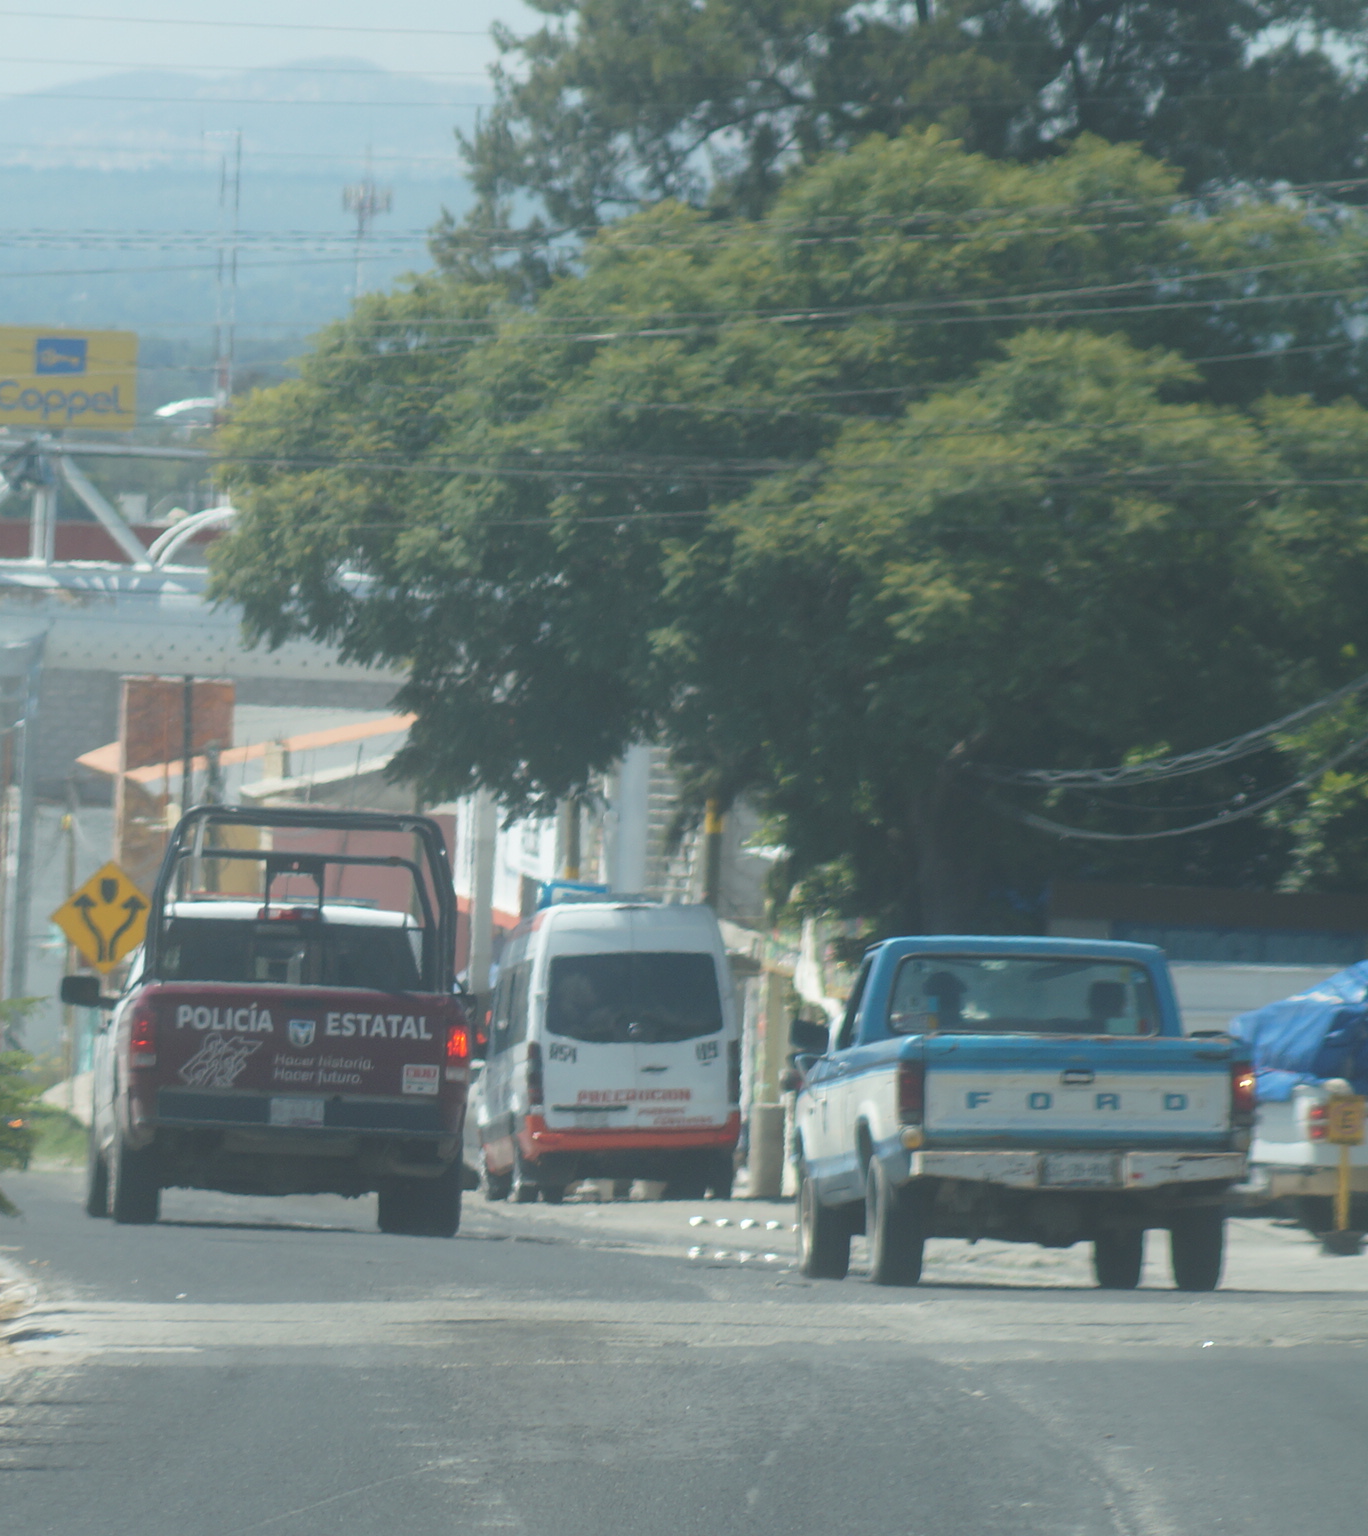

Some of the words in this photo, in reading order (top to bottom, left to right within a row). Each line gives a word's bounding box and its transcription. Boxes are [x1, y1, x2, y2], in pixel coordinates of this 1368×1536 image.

[176, 1002, 274, 1033] POLICÍA
[325, 1012, 433, 1041] ESTATAL
[274, 1053, 314, 1067] Hacer
[318, 1054, 375, 1071] historia.
[273, 1067, 314, 1082] Hacer
[318, 1068, 363, 1085] futuro.
[966, 1091, 1187, 1111] FORD
